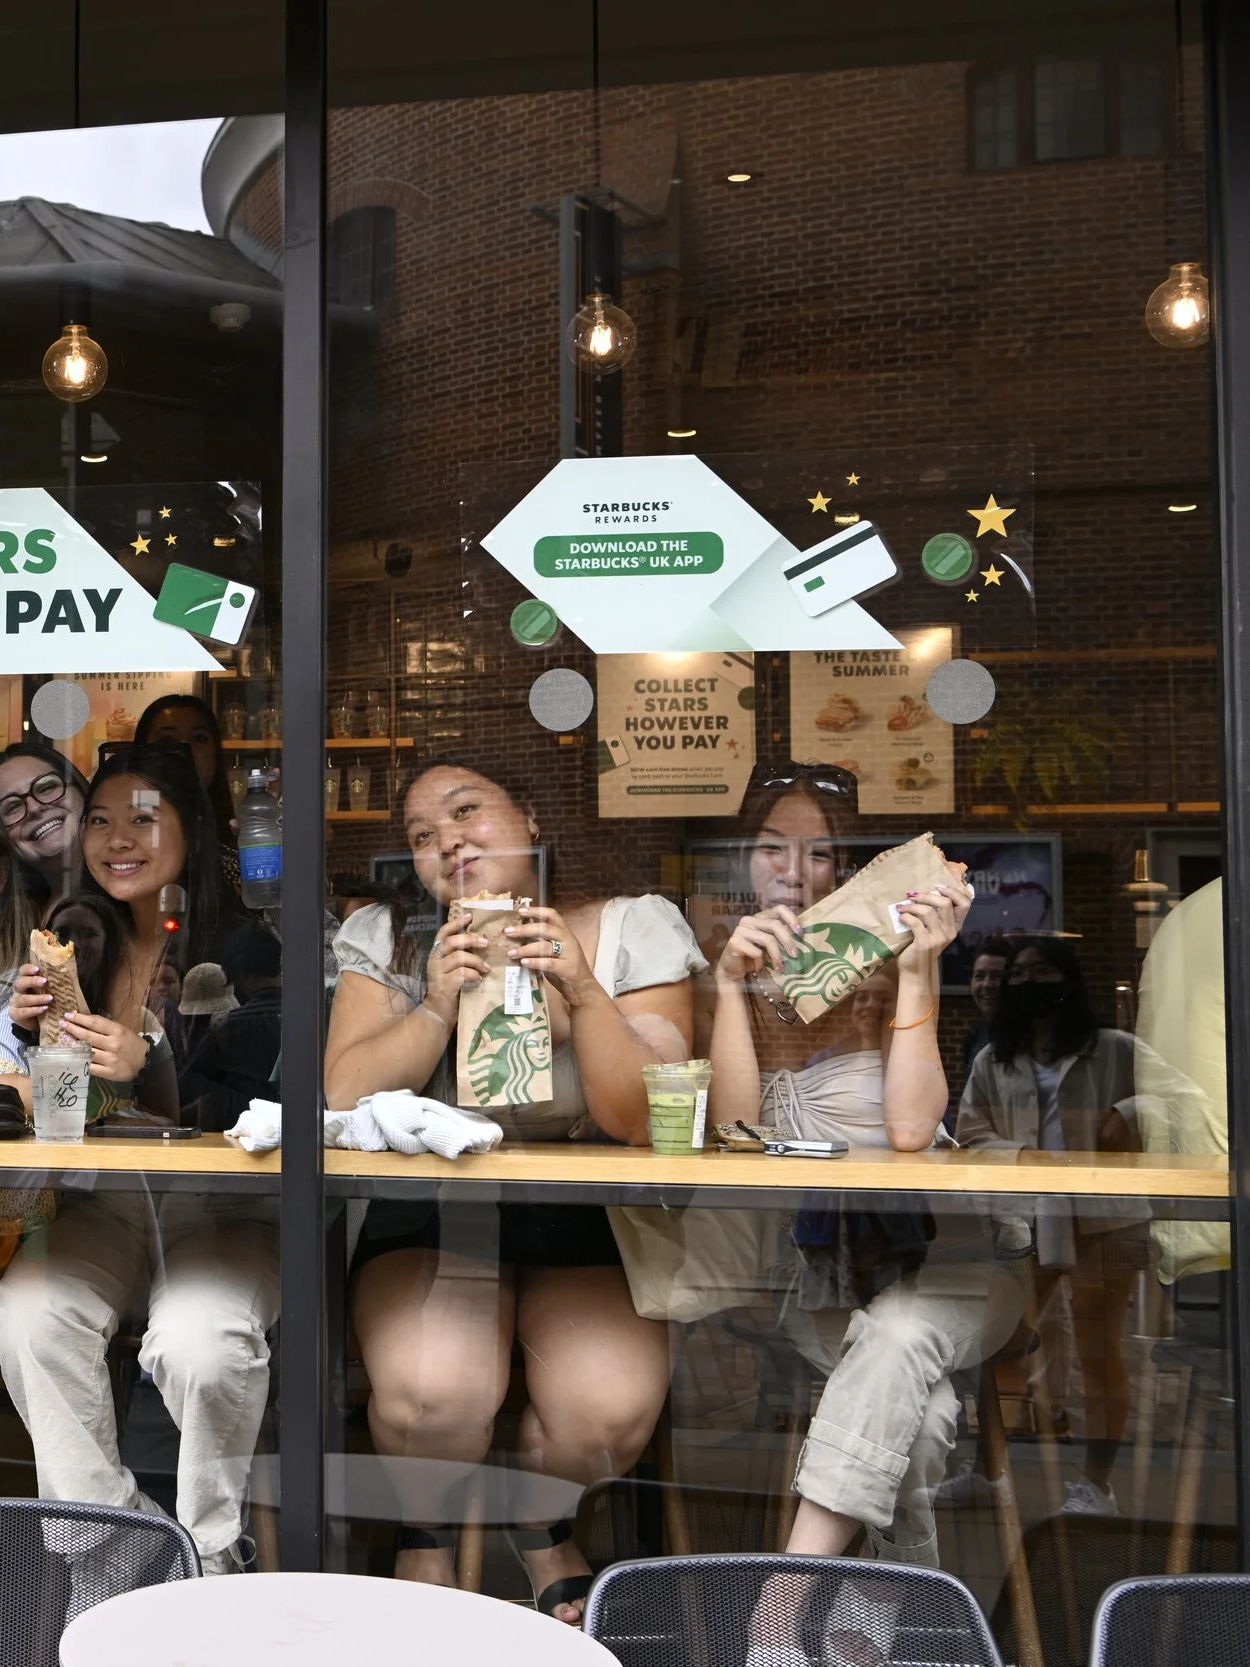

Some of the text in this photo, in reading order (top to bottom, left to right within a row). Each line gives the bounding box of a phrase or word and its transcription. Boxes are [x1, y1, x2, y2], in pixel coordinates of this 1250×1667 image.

[595, 515, 657, 524] REWARDS
[569, 540, 688, 554] DOWNLOAD THE
[650, 556, 670, 568] UK
[673, 555, 703, 567] APP
[5, 587, 123, 635] PAY
[814, 651, 845, 664] THE
[850, 650, 902, 663] TASTE
[74, 672, 120, 680] SUMMER
[832, 665, 910, 677] SUMMER
[101, 682, 144, 691] IS HERE
[634, 678, 718, 694] COLLECT
[644, 697, 709, 713] STARS
[625, 715, 729, 732] HOWEVER
[633, 734, 720, 750] YOU PAY
